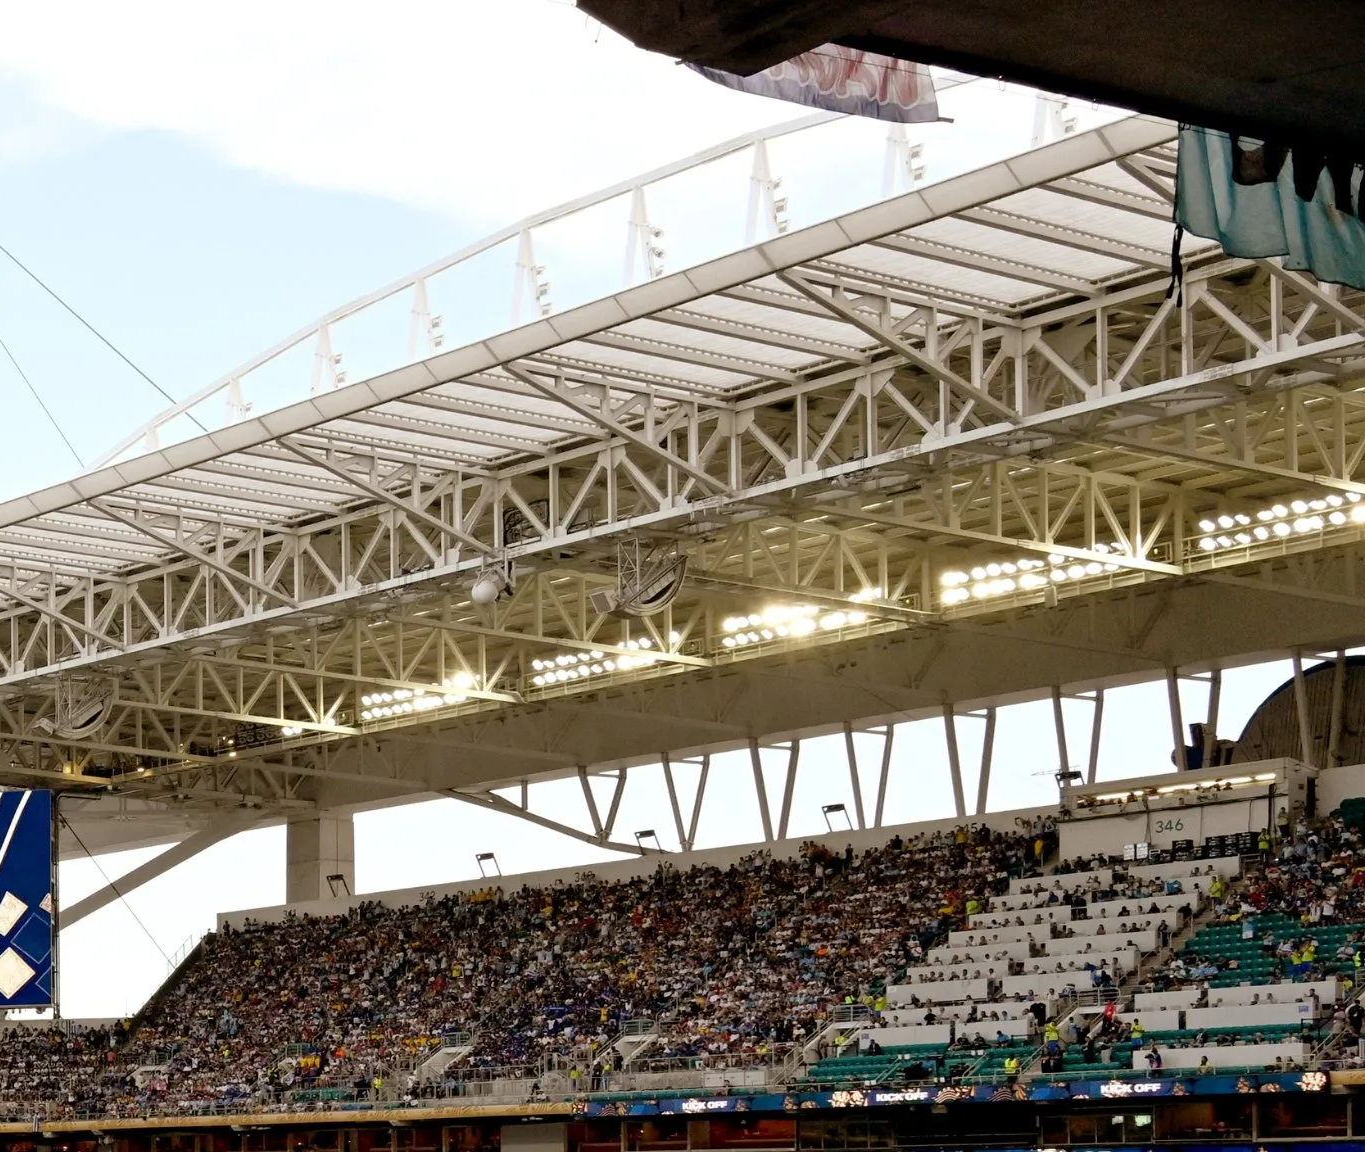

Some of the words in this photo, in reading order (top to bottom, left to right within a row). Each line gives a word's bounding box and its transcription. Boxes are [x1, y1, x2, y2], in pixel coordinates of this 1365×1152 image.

[1155, 818, 1183, 833] 346
[1100, 1084, 1133, 1094] KICK
[1134, 1083, 1161, 1092] OFF
[876, 1094, 904, 1102] KICK
[682, 1101, 706, 1110] KICK
[707, 1101, 728, 1109] OFF
